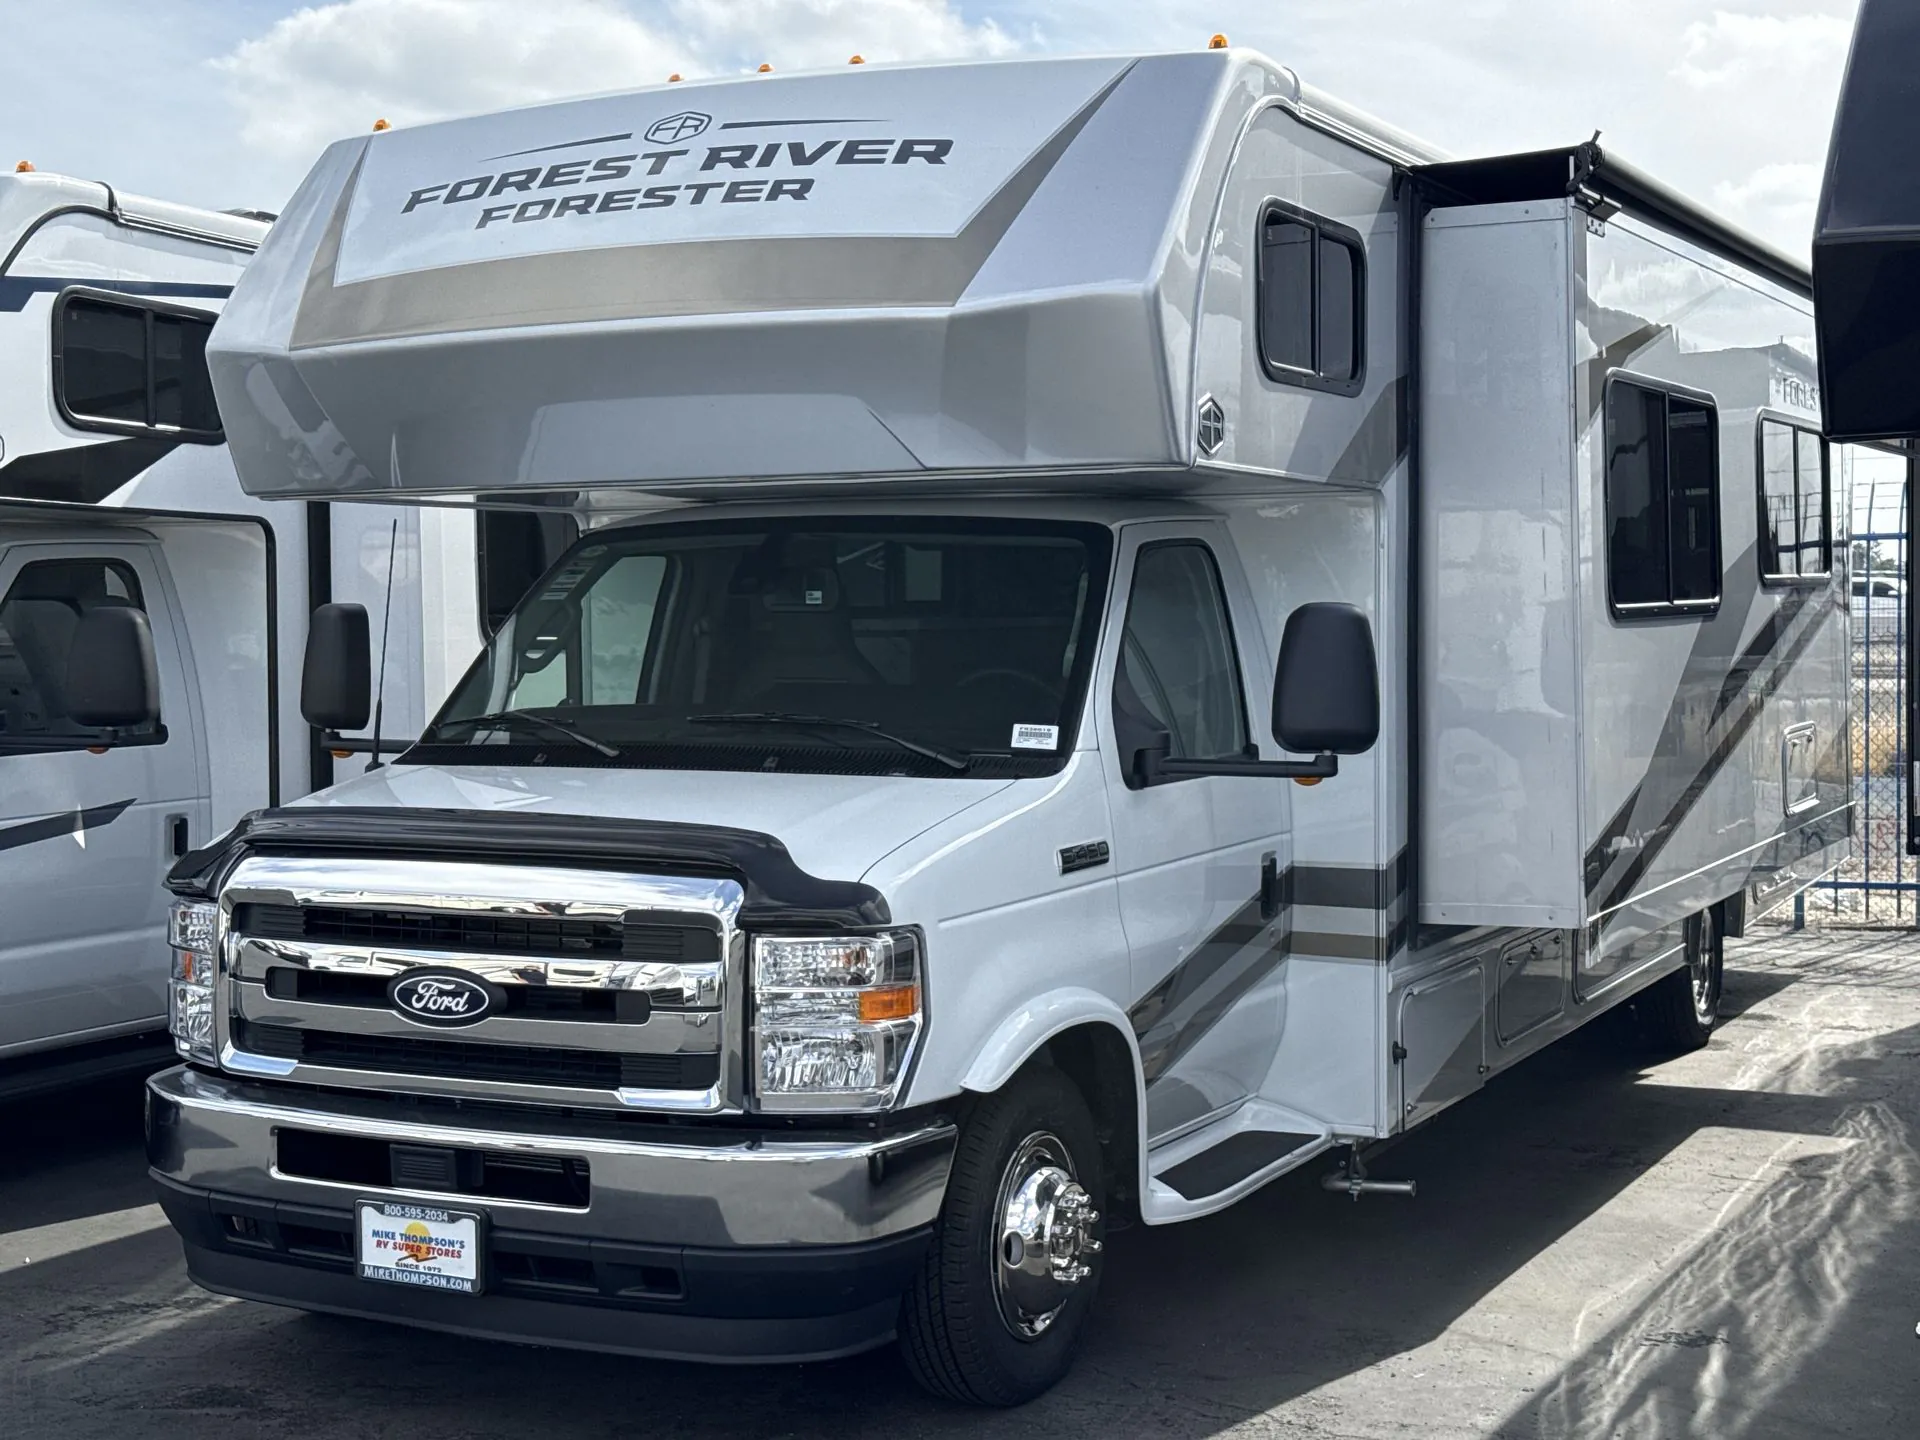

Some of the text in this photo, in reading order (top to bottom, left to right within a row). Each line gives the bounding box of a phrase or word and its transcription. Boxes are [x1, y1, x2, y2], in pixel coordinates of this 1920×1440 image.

[401, 138, 954, 214] FOREST RIVER
[474, 178, 815, 230] FORESTER
[411, 981, 470, 1012] Ford
[384, 1204, 449, 1222] 800-595-2034
[371, 1228, 466, 1250] MIKE THOMPSON'S
[375, 1239, 463, 1259] RV SUPER STORES
[395, 1261, 420, 1271] SINCE
